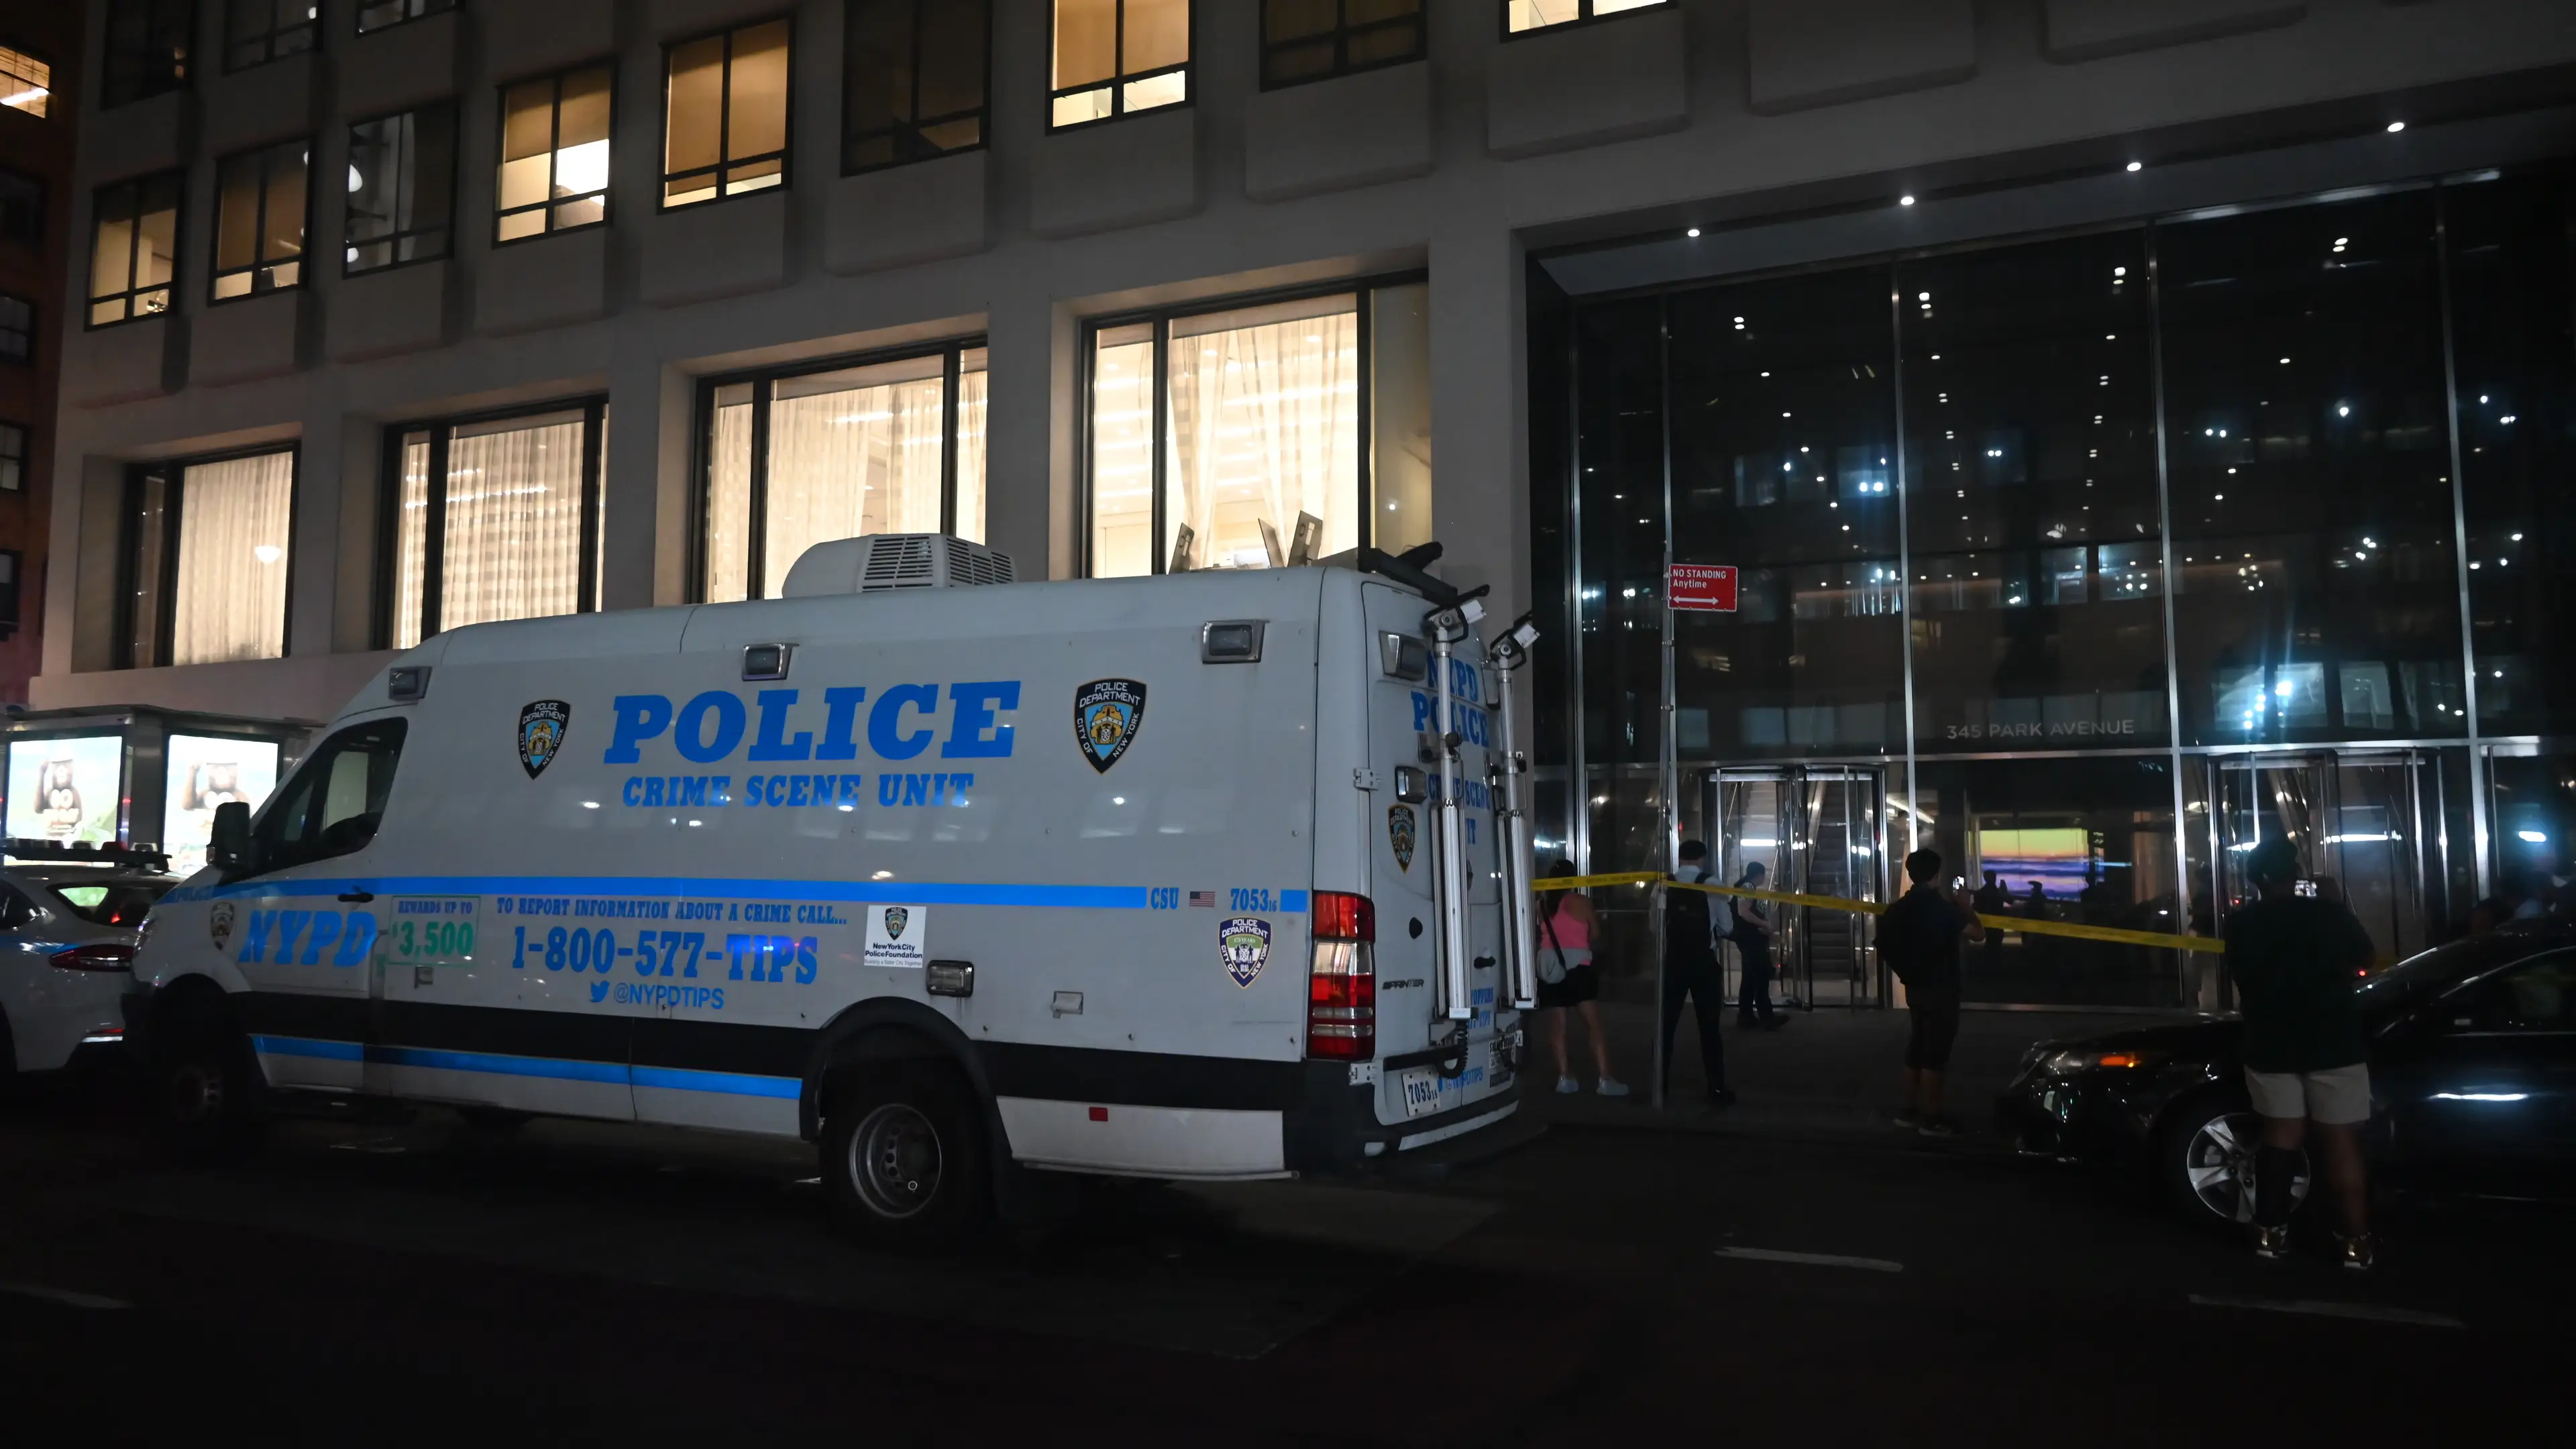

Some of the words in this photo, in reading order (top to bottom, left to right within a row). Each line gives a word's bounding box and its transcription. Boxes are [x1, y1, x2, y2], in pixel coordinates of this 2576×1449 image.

[1673, 568, 1684, 578] NO
[1686, 569, 1727, 580] STANDING
[1673, 579, 1707, 589] Anytime
[1095, 682, 1128, 693] POLICE
[534, 702, 559, 712] POLICE
[1079, 690, 1140, 708] DEPARTMENT
[523, 711, 566, 724] DEPARTMENT
[604, 680, 1021, 764] POLICE
[1076, 717, 1087, 739] CITY
[1083, 742, 1093, 754] OF
[1112, 737, 1128, 758] NEW
[1126, 712, 1140, 735] YORK
[1946, 724, 1982, 740] 345
[1988, 722, 2043, 738] PARK
[2050, 719, 2135, 736] AVENUE
[542, 749, 555, 766] NEW
[623, 775, 731, 807] CRIME
[743, 774, 861, 807] SCENE
[878, 772, 975, 807] UNIT
[398, 901, 441, 914] REWARDS
[445, 901, 458, 914] UP
[460, 901, 473, 914] TO
[1150, 887, 1179, 910] CSU
[497, 897, 514, 914] TO
[518, 898, 570, 916] REPORT
[574, 899, 671, 919] INFORMATION
[675, 902, 723, 921] ABOUT
[729, 903, 738, 921] A
[744, 904, 792, 922] CRIME
[797, 906, 847, 924] CALL...
[1222, 926, 1268, 939] DEPARTMENT
[1232, 918, 1258, 927] POLICE
[237, 910, 378, 968] NYPD
[512, 926, 818, 985] 1-800-577-TIPS
[1221, 945, 1230, 962] CITY
[1227, 963, 1236, 973] OF
[1250, 961, 1262, 977] NEW
[1259, 943, 1269, 961] YORK
[613, 981, 725, 1010] @NYPDTIPS
